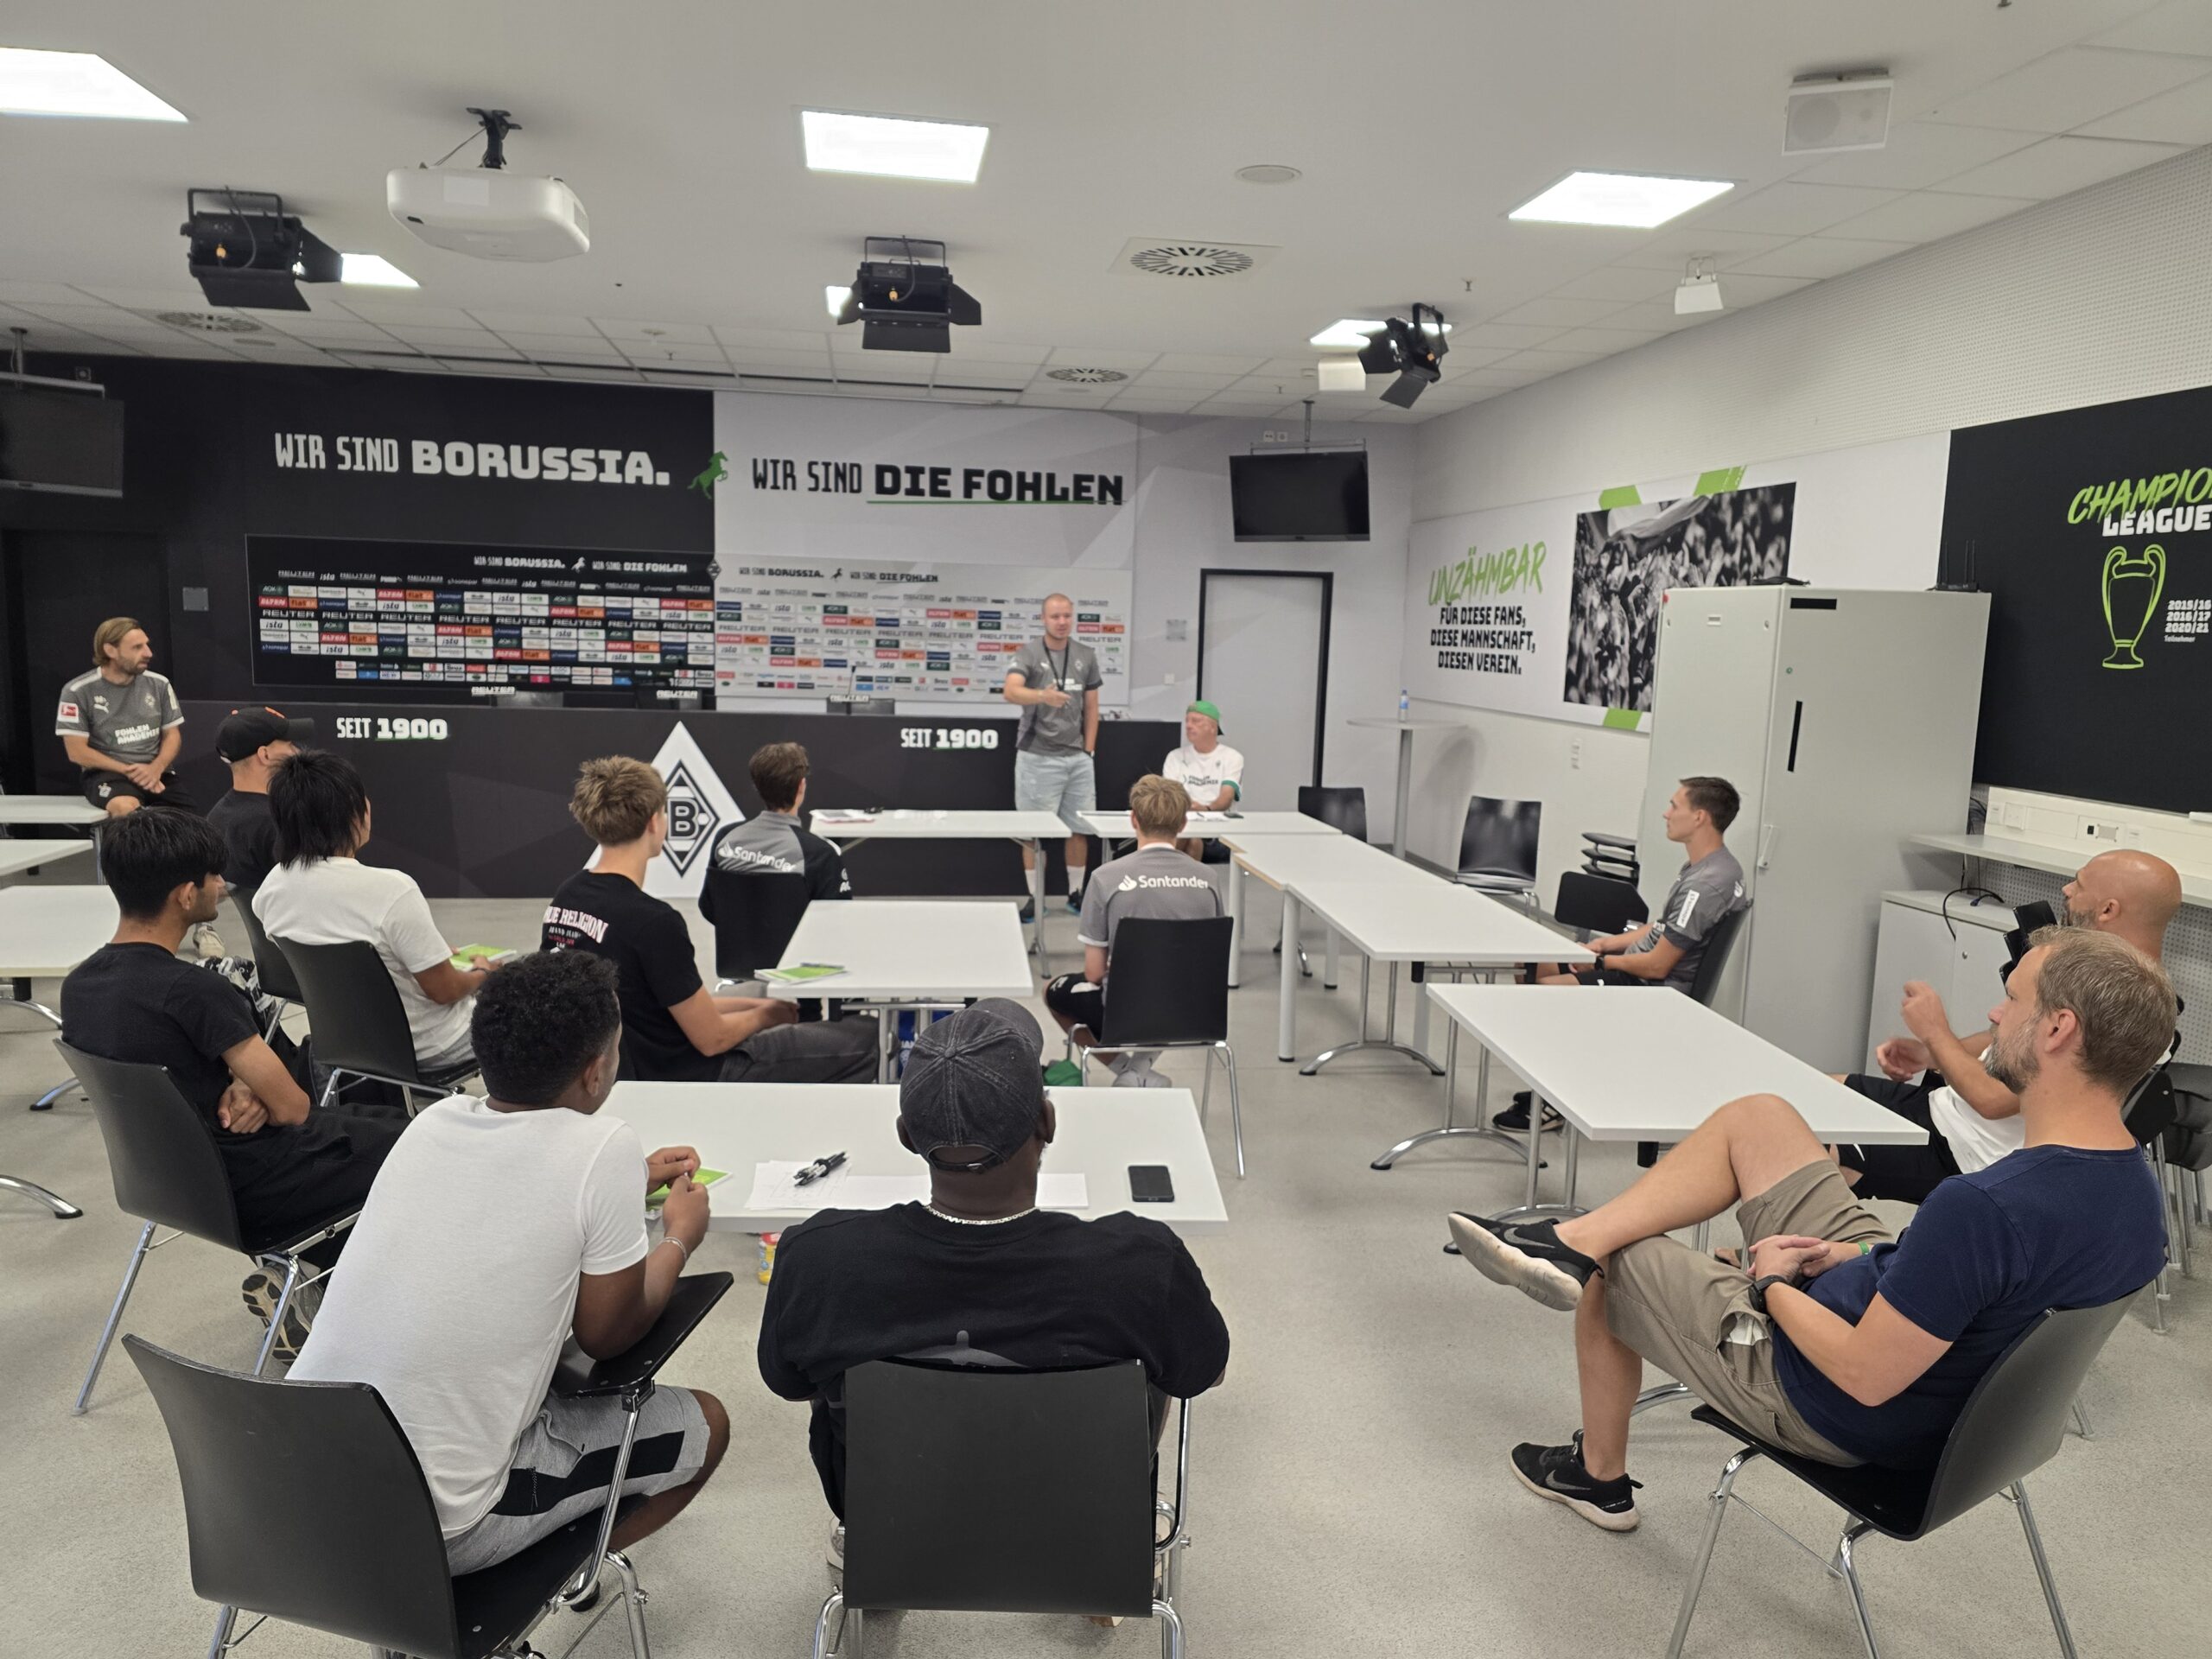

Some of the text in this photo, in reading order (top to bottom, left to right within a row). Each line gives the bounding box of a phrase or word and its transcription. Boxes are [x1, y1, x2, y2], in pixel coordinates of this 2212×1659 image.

[275, 432, 671, 486] WIR SIND BORUSSIA.
[752, 457, 1123, 505] WIR SIND DIE FOHLEN
[2067, 467, 2212, 524] CHAMPIO
[2101, 503, 2212, 537] LEAGUE
[505, 556, 566, 569] BORUSSIA.
[623, 562, 644, 572] DIE
[645, 563, 688, 573] FOHLEN
[767, 568, 824, 578] BORUSSIA.
[1428, 540, 1547, 606] UNZÄHMBAR
[879, 572, 898, 581] DIE
[899, 573, 938, 582] FOHLEN
[1440, 602, 1527, 628] FÜR DIESE FANS,
[2165, 610, 2211, 622] 2016/17
[2167, 598, 2212, 611] 2015/16
[262, 608, 711, 631] REUTER REUTER REUTER REUTER REUTER REUTER REUTER REUTER
[718, 624, 766, 632] REUTER
[2164, 621, 2209, 633] 2020/21
[1430, 628, 1536, 654] DIESE MANNSCHAFT,
[1438, 651, 1522, 675] DIESEN VEREIN.
[115, 723, 150, 738] FOHLEN
[336, 717, 448, 741] SEIT 1900
[900, 728, 999, 749] SEIT 1900
[667, 798, 699, 841] B
[734, 846, 796, 872] Santander
[1138, 874, 1209, 889] Santander
[558, 907, 609, 944] RELIGION
